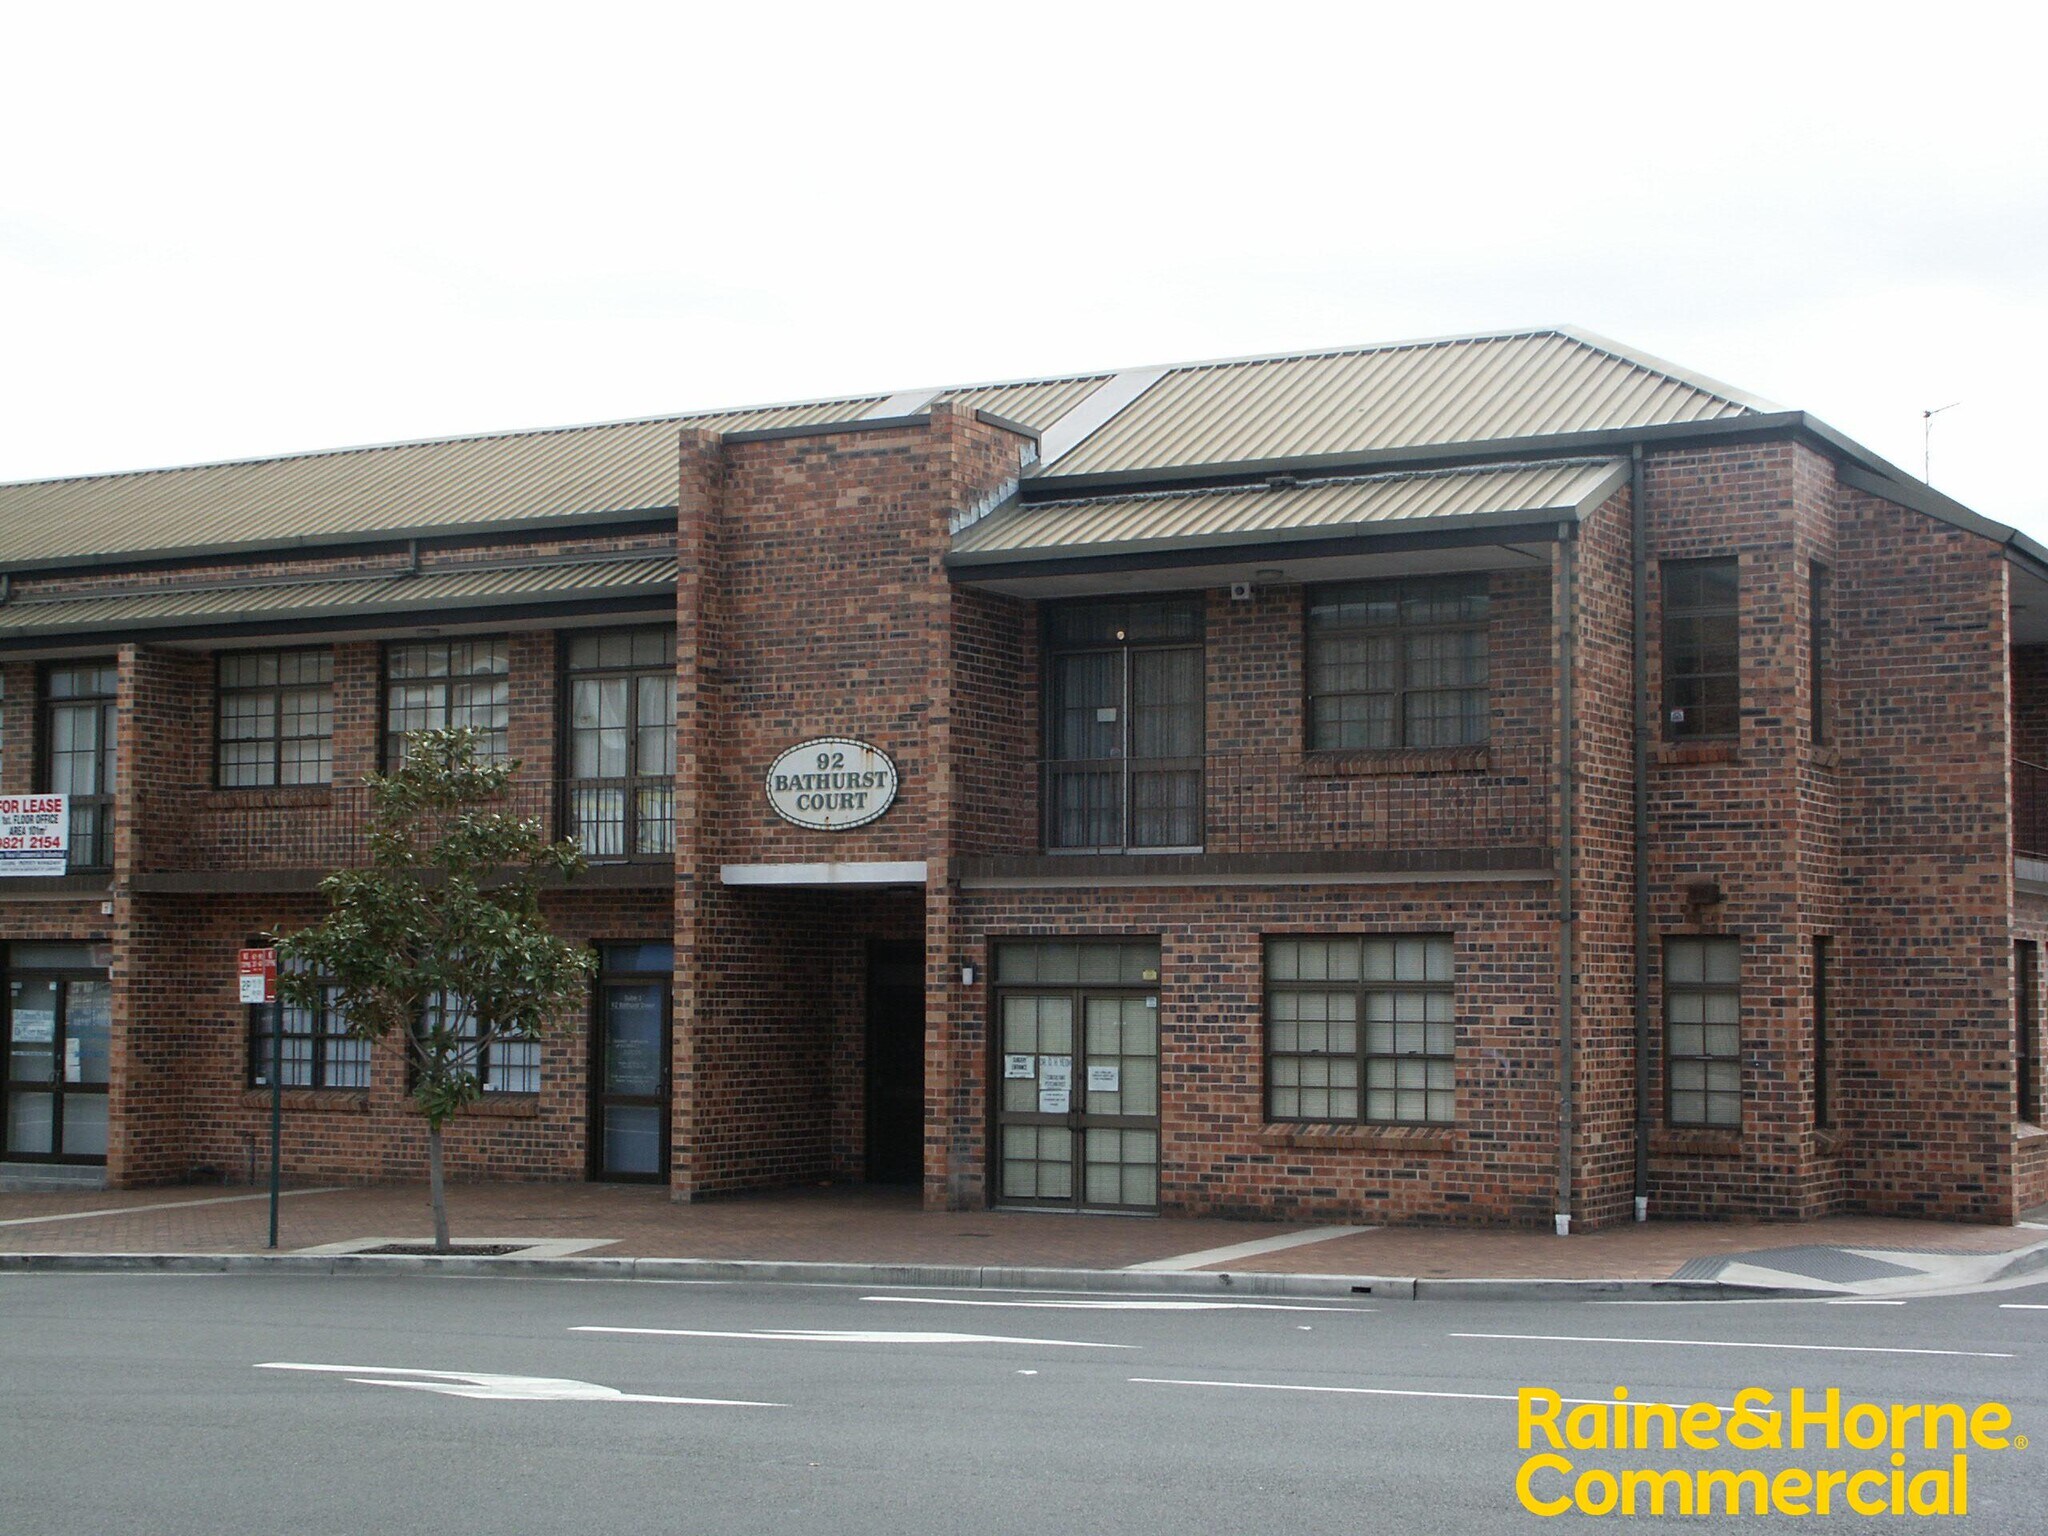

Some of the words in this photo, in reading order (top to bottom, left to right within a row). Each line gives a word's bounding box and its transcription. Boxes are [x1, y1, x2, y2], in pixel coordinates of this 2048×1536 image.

[817, 753, 844, 769] 92
[775, 771, 888, 791] BATHURST
[23, 798, 62, 813] LEASE
[796, 792, 868, 810] COURT
[13, 815, 34, 825] FLOOR
[36, 814, 59, 824] OFFICE
[9, 826, 26, 836] AREA
[30, 836, 60, 849] 2154
